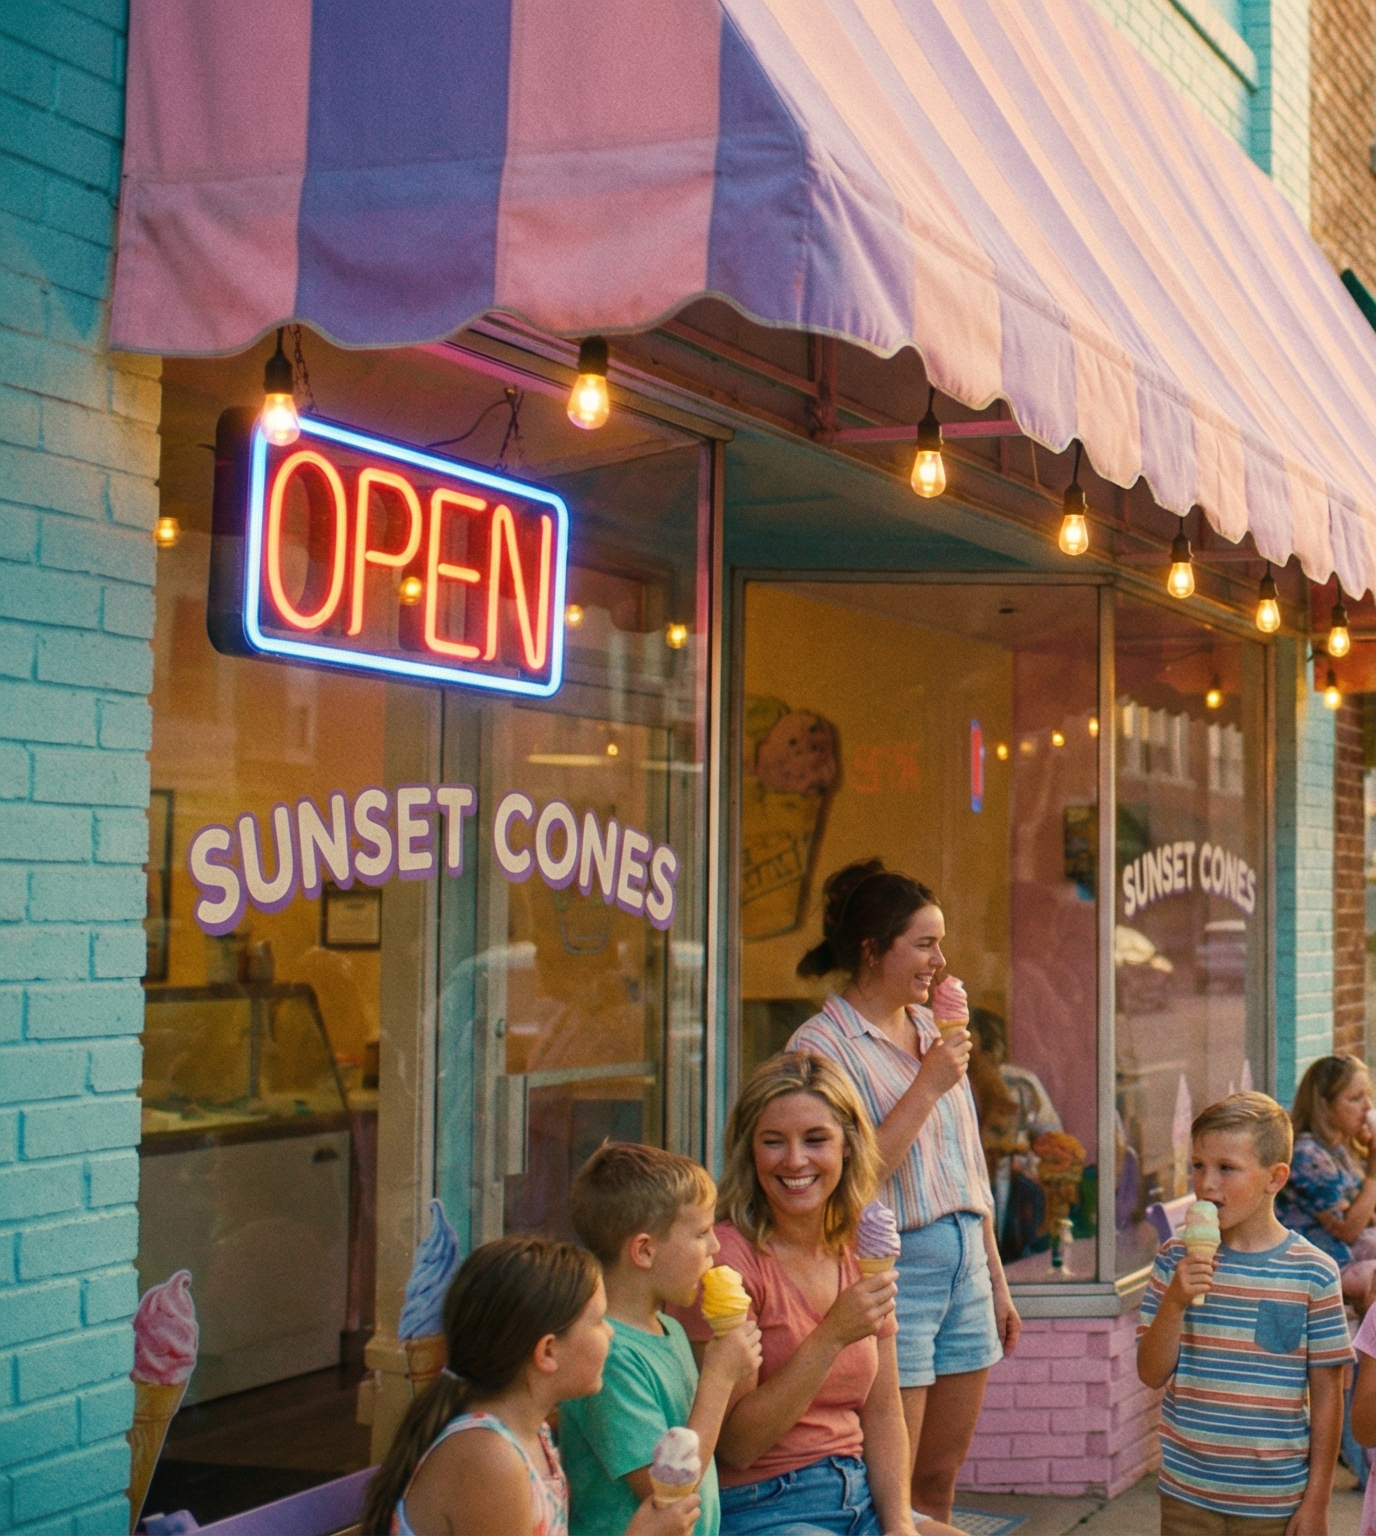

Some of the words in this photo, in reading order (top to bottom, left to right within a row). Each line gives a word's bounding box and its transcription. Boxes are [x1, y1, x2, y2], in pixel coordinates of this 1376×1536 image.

[266, 449, 553, 670] OPEN
[187, 783, 478, 937] SUNSET
[494, 788, 680, 931] CONES
[1122, 841, 1196, 920] SUNSET
[1199, 841, 1257, 917] CONES
